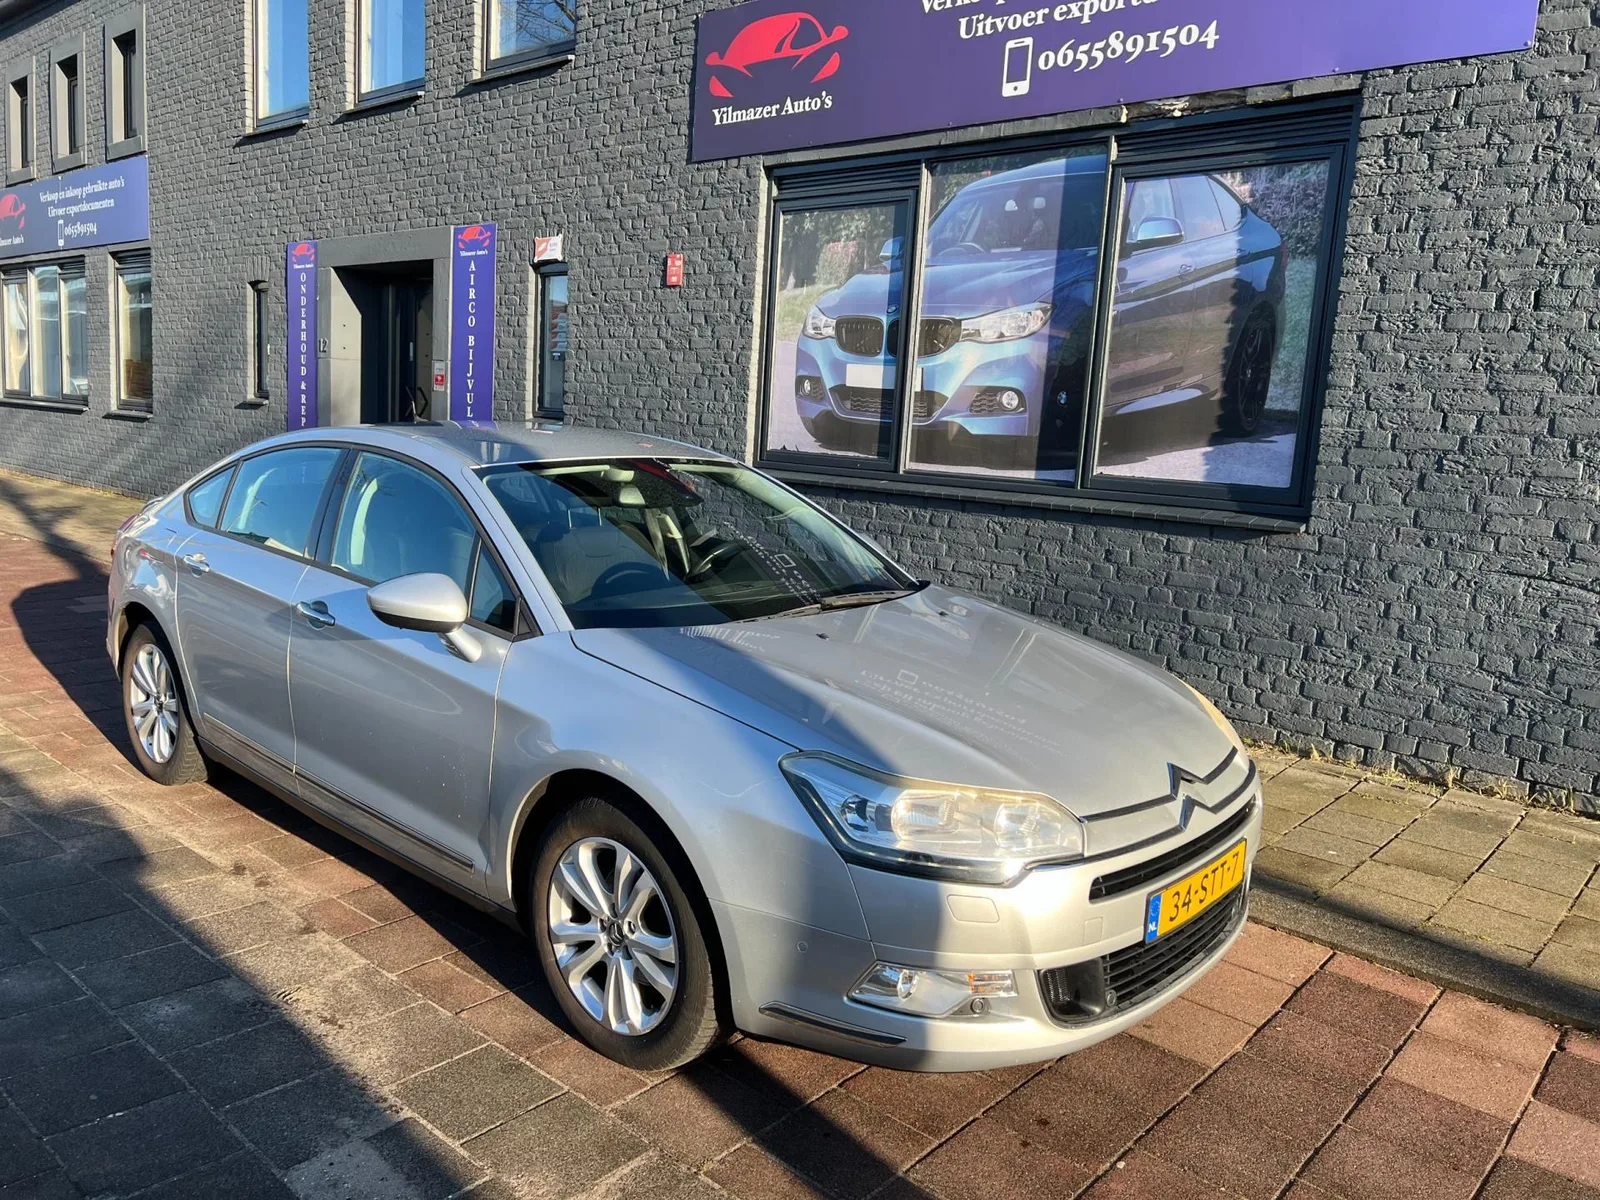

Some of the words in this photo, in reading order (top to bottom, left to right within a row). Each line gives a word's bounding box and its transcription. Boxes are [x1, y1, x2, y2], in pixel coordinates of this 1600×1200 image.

[958, 8, 1050, 39] Uitvoer
[1038, 18, 1219, 72] 0655891504
[712, 105, 780, 125] Yilmazer
[781, 91, 833, 115] Auto's
[39, 191, 58, 204] Verkoop
[59, 191, 65, 199] en
[65, 186, 82, 199] inkoop
[82, 180, 108, 198] gebruikte
[48, 206, 65, 217] Uitvoer
[66, 199, 115, 217] exportdocumenten
[64, 222, 97, 238] 0655891504
[468, 260, 476, 327] AIRCO
[318, 338, 329, 353] 12
[466, 335, 475, 417] BIJVUL
[1169, 851, 1240, 922] 34-STT-7
[1148, 921, 1157, 933] NL
